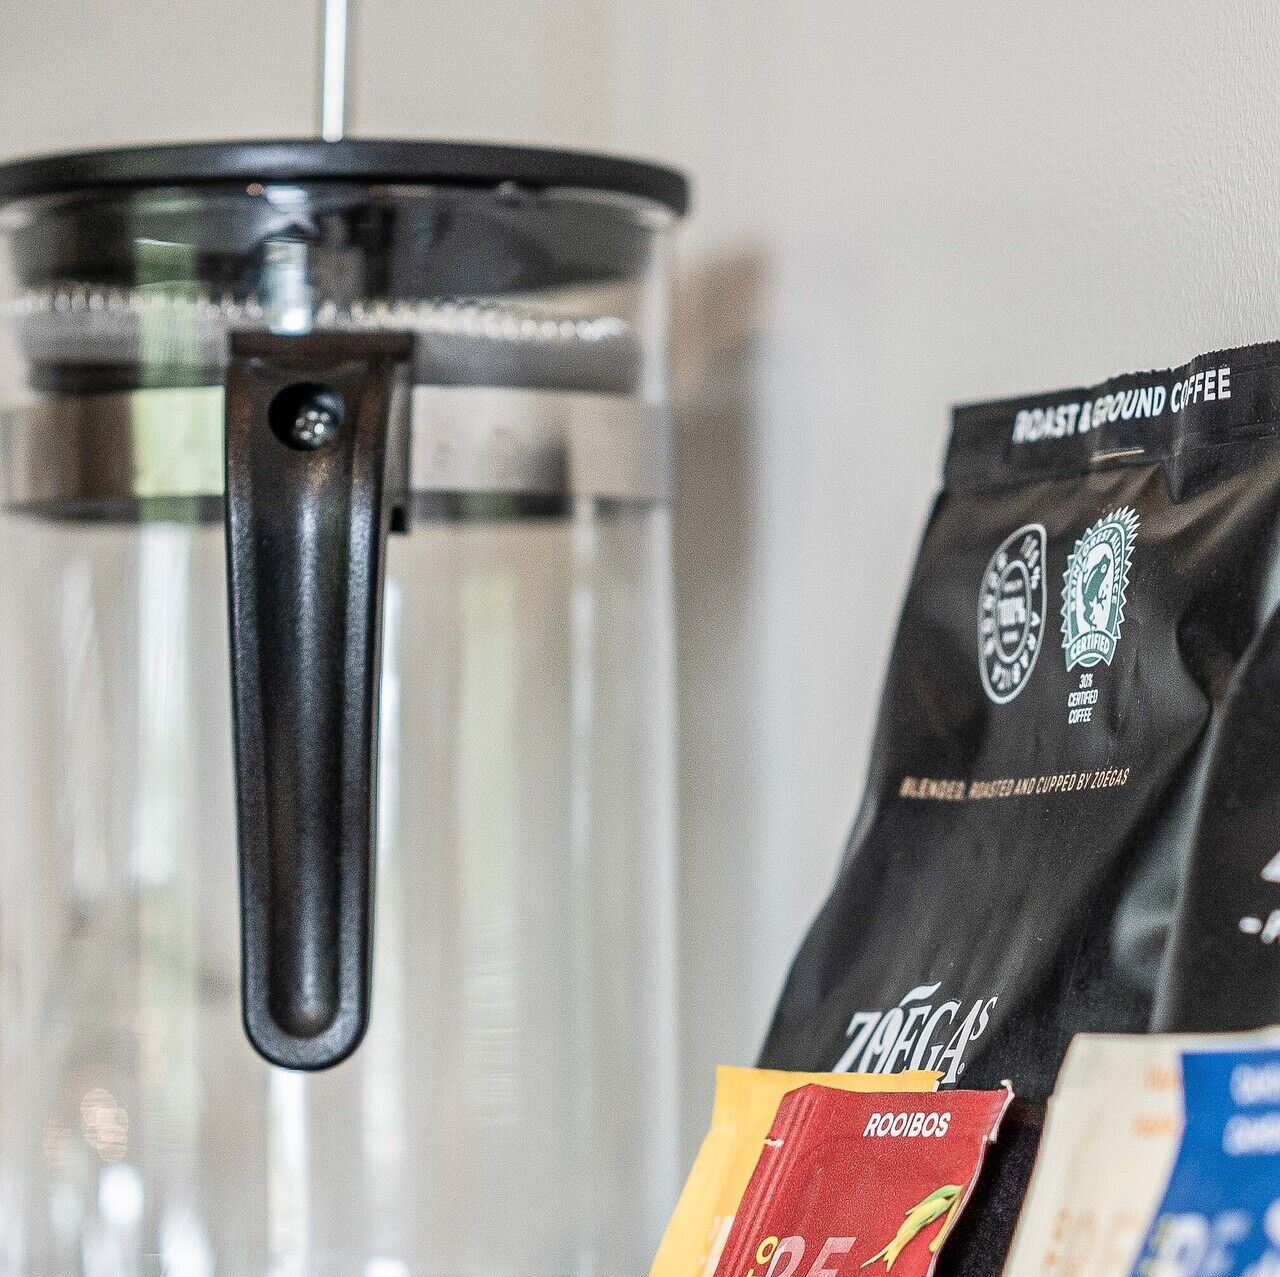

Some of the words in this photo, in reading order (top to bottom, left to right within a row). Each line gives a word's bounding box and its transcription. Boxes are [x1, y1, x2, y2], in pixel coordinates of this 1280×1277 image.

[1170, 367, 1232, 413] COFFEE
[1070, 634, 1110, 661] CERTIFIED
[1067, 689, 1099, 708] CERTIFIED
[1068, 707, 1093, 724] COFFEE
[1013, 777, 1036, 796] AND
[1035, 774, 1075, 794] CUPPED
[1075, 772, 1092, 791] BY
[862, 1112, 952, 1138] ROOIBOS
